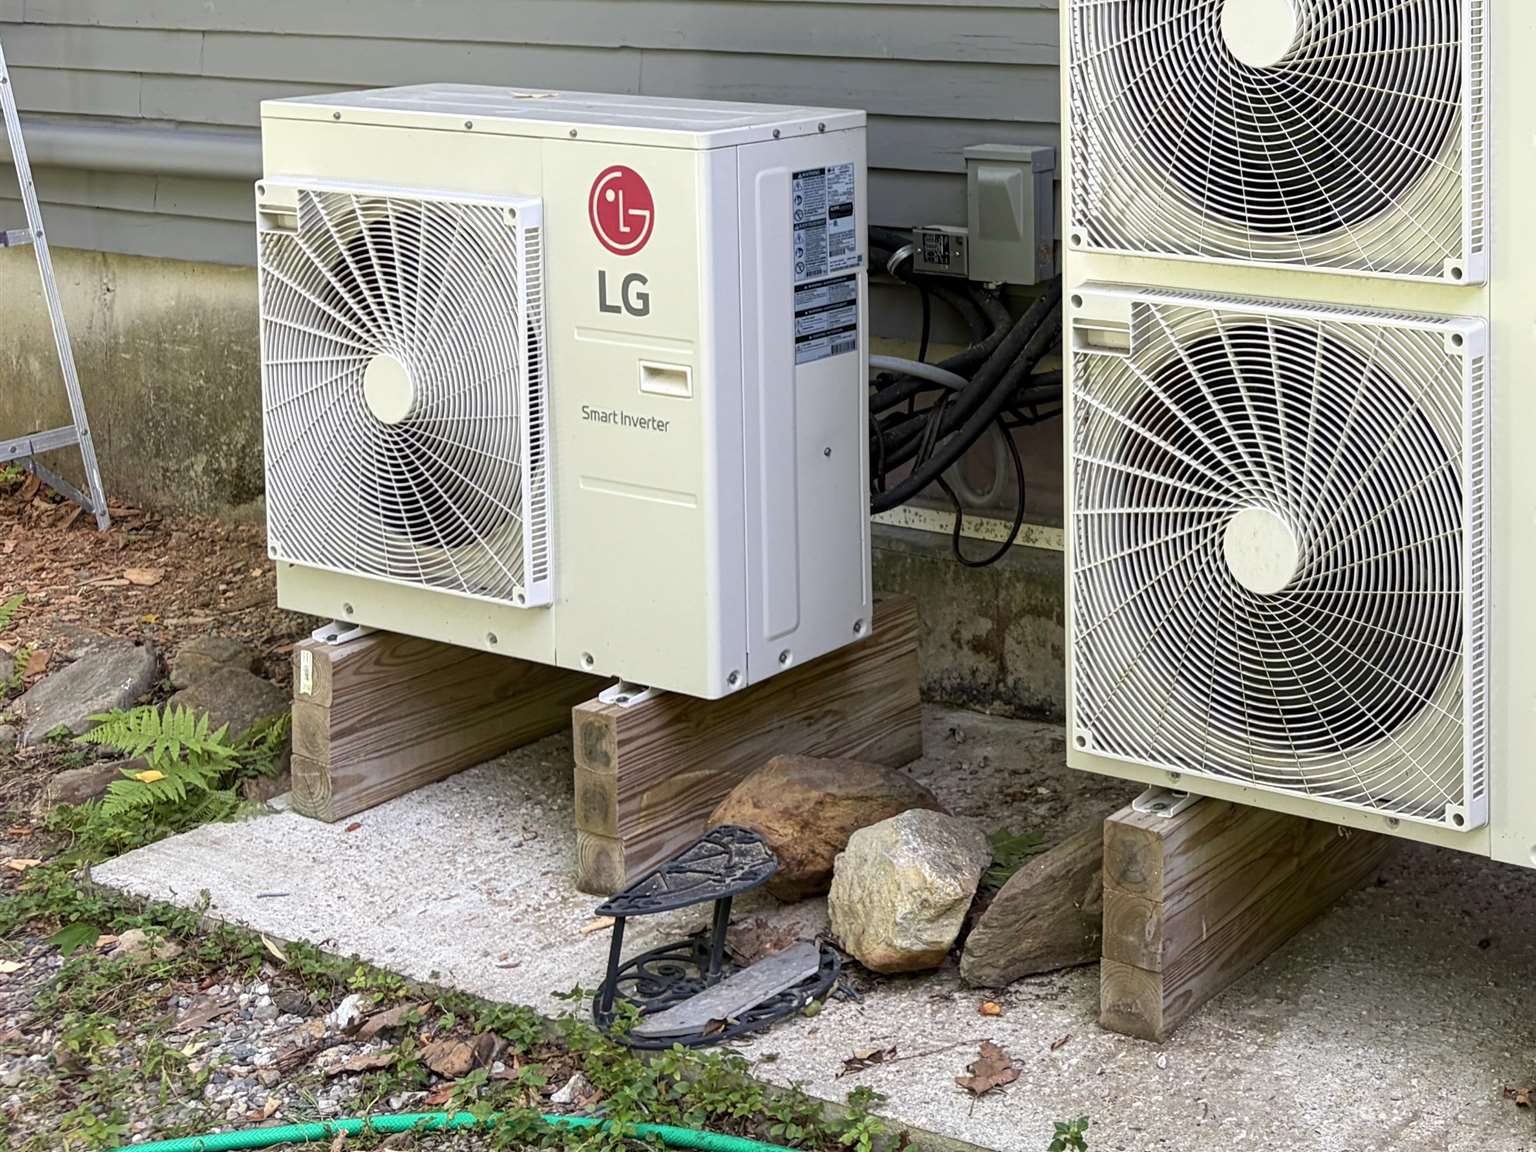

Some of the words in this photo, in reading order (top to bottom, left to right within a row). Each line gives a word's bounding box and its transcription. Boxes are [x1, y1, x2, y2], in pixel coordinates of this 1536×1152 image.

[598, 268, 650, 317] LG
[581, 404, 618, 425] Smart
[620, 410, 670, 433] Inverter
